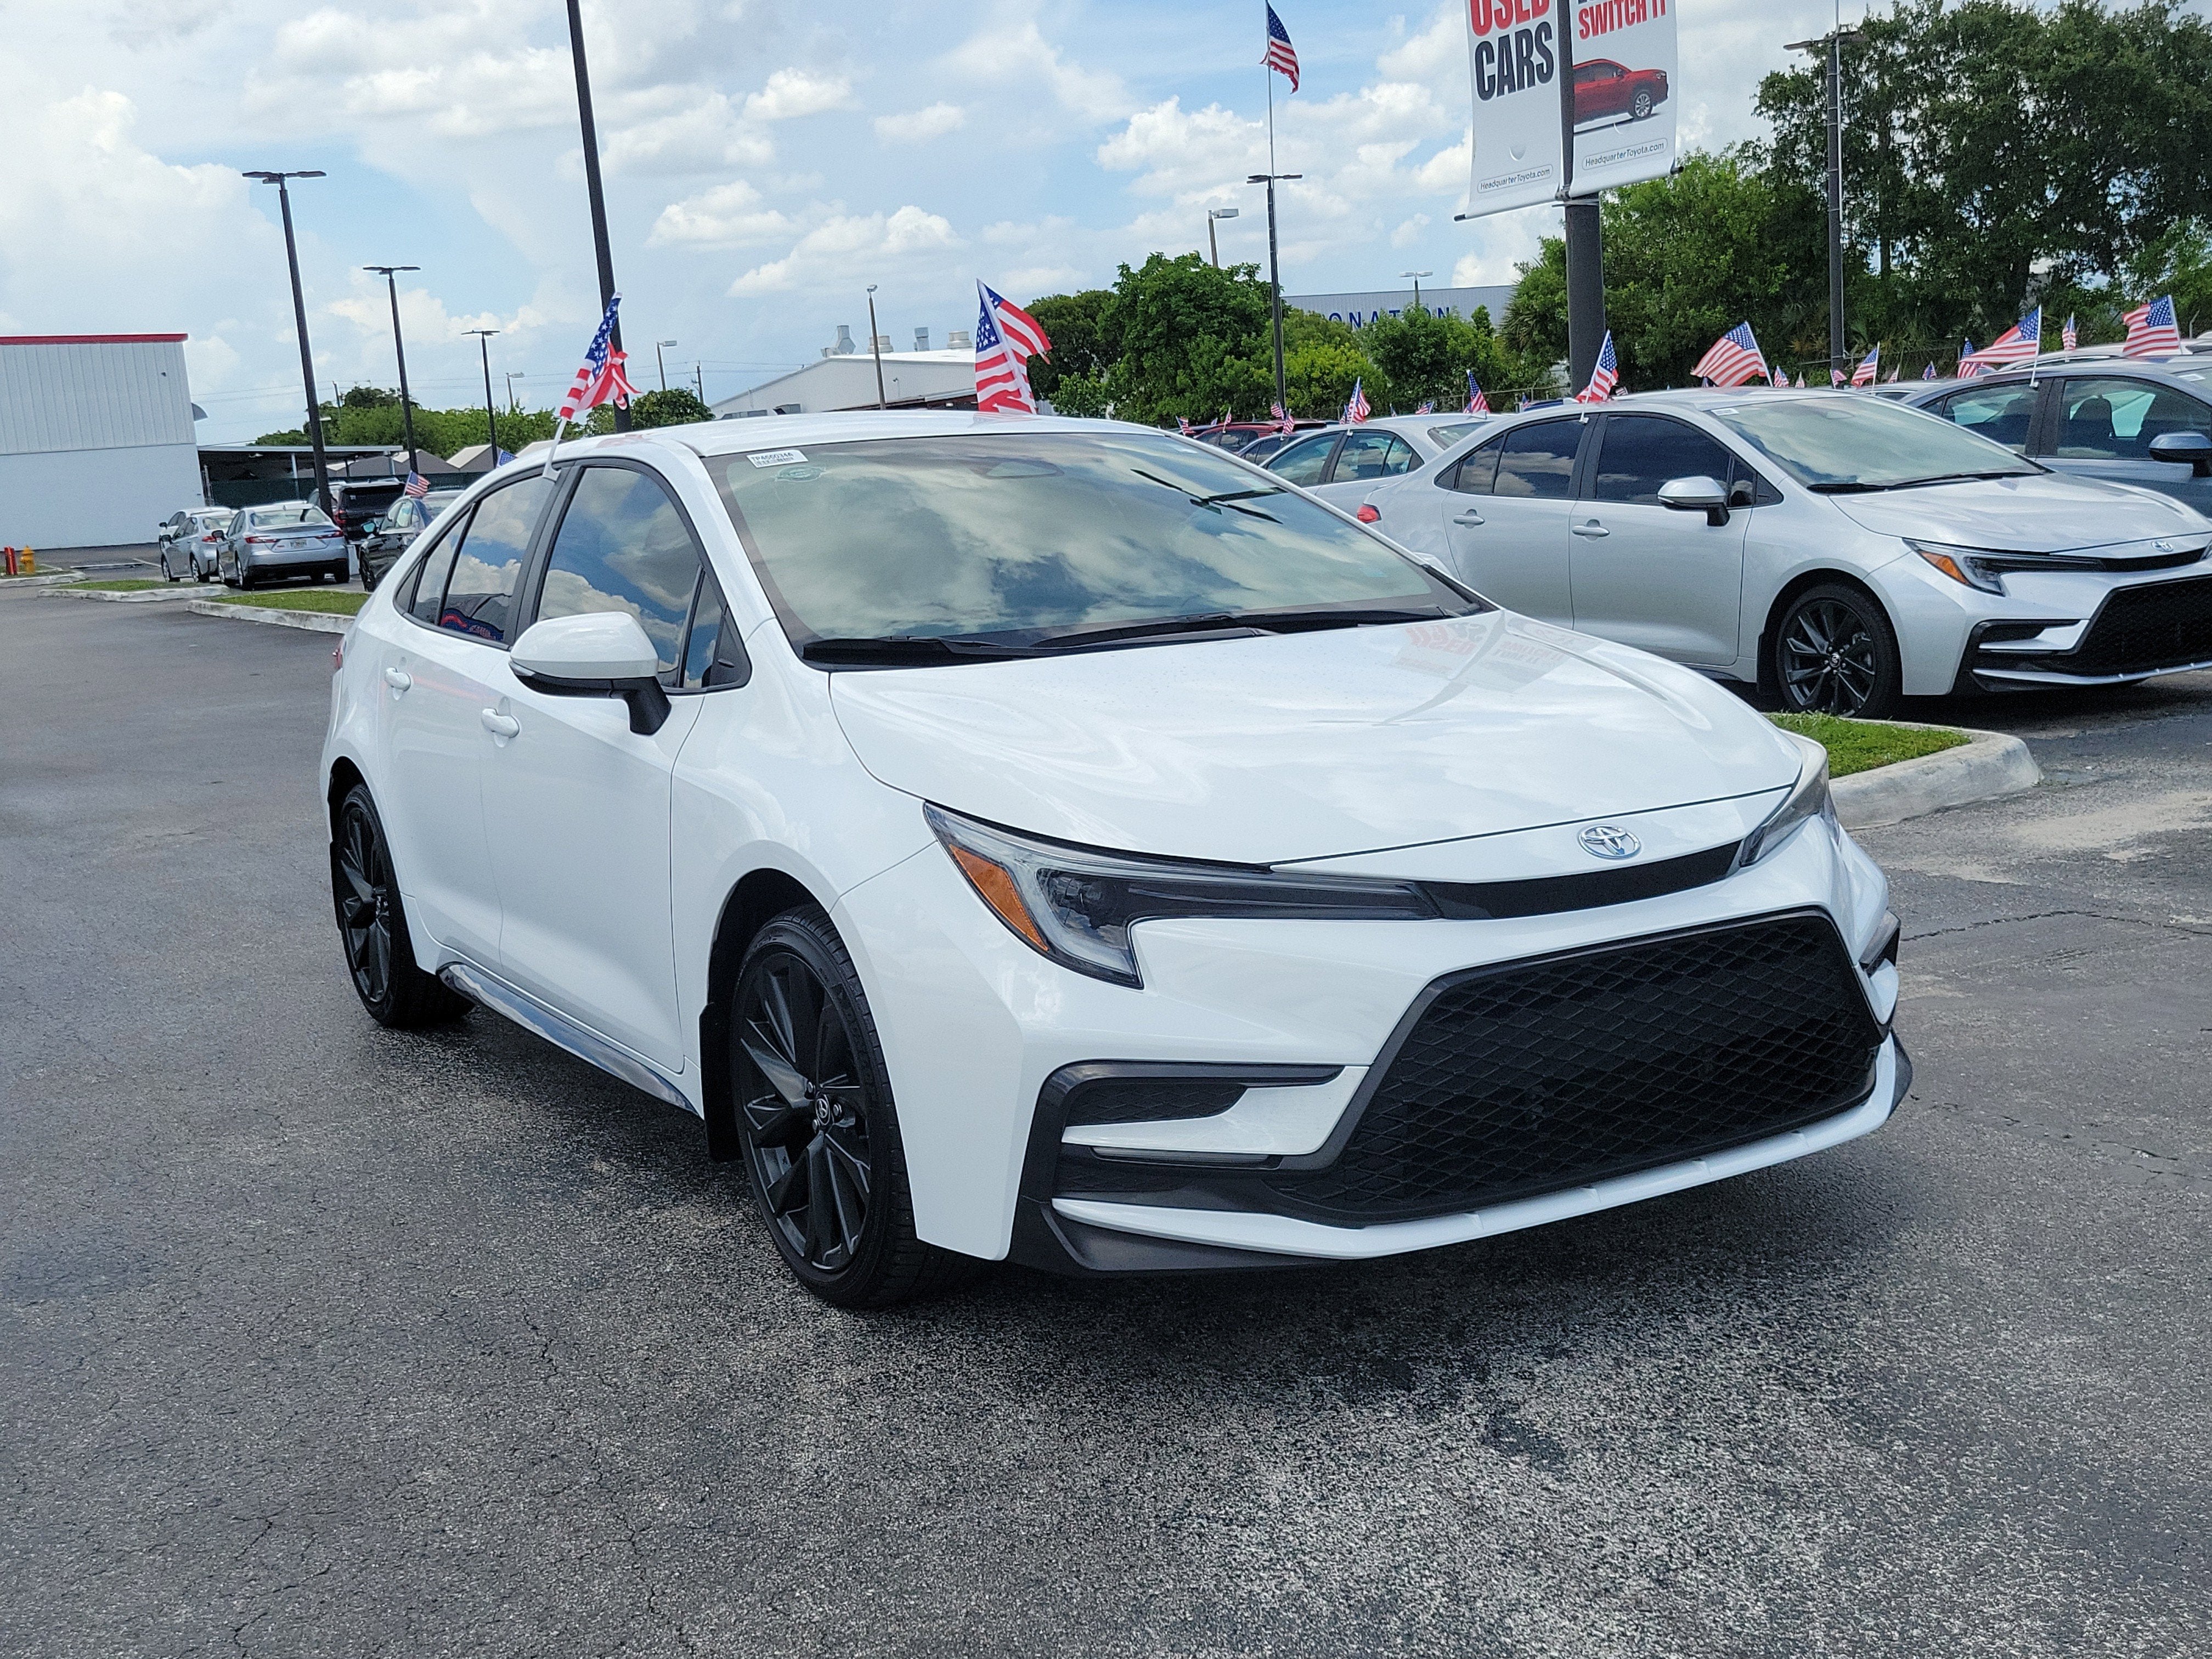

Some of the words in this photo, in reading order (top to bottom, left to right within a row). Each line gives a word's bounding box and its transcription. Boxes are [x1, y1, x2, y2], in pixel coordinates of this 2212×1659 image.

[1578, 0, 1647, 40] SWITCH
[1475, 21, 1554, 101] CARS
[1585, 143, 1664, 167] HeadquarterToyota.com
[1481, 168, 1550, 190] HeadquarterToyota.com
